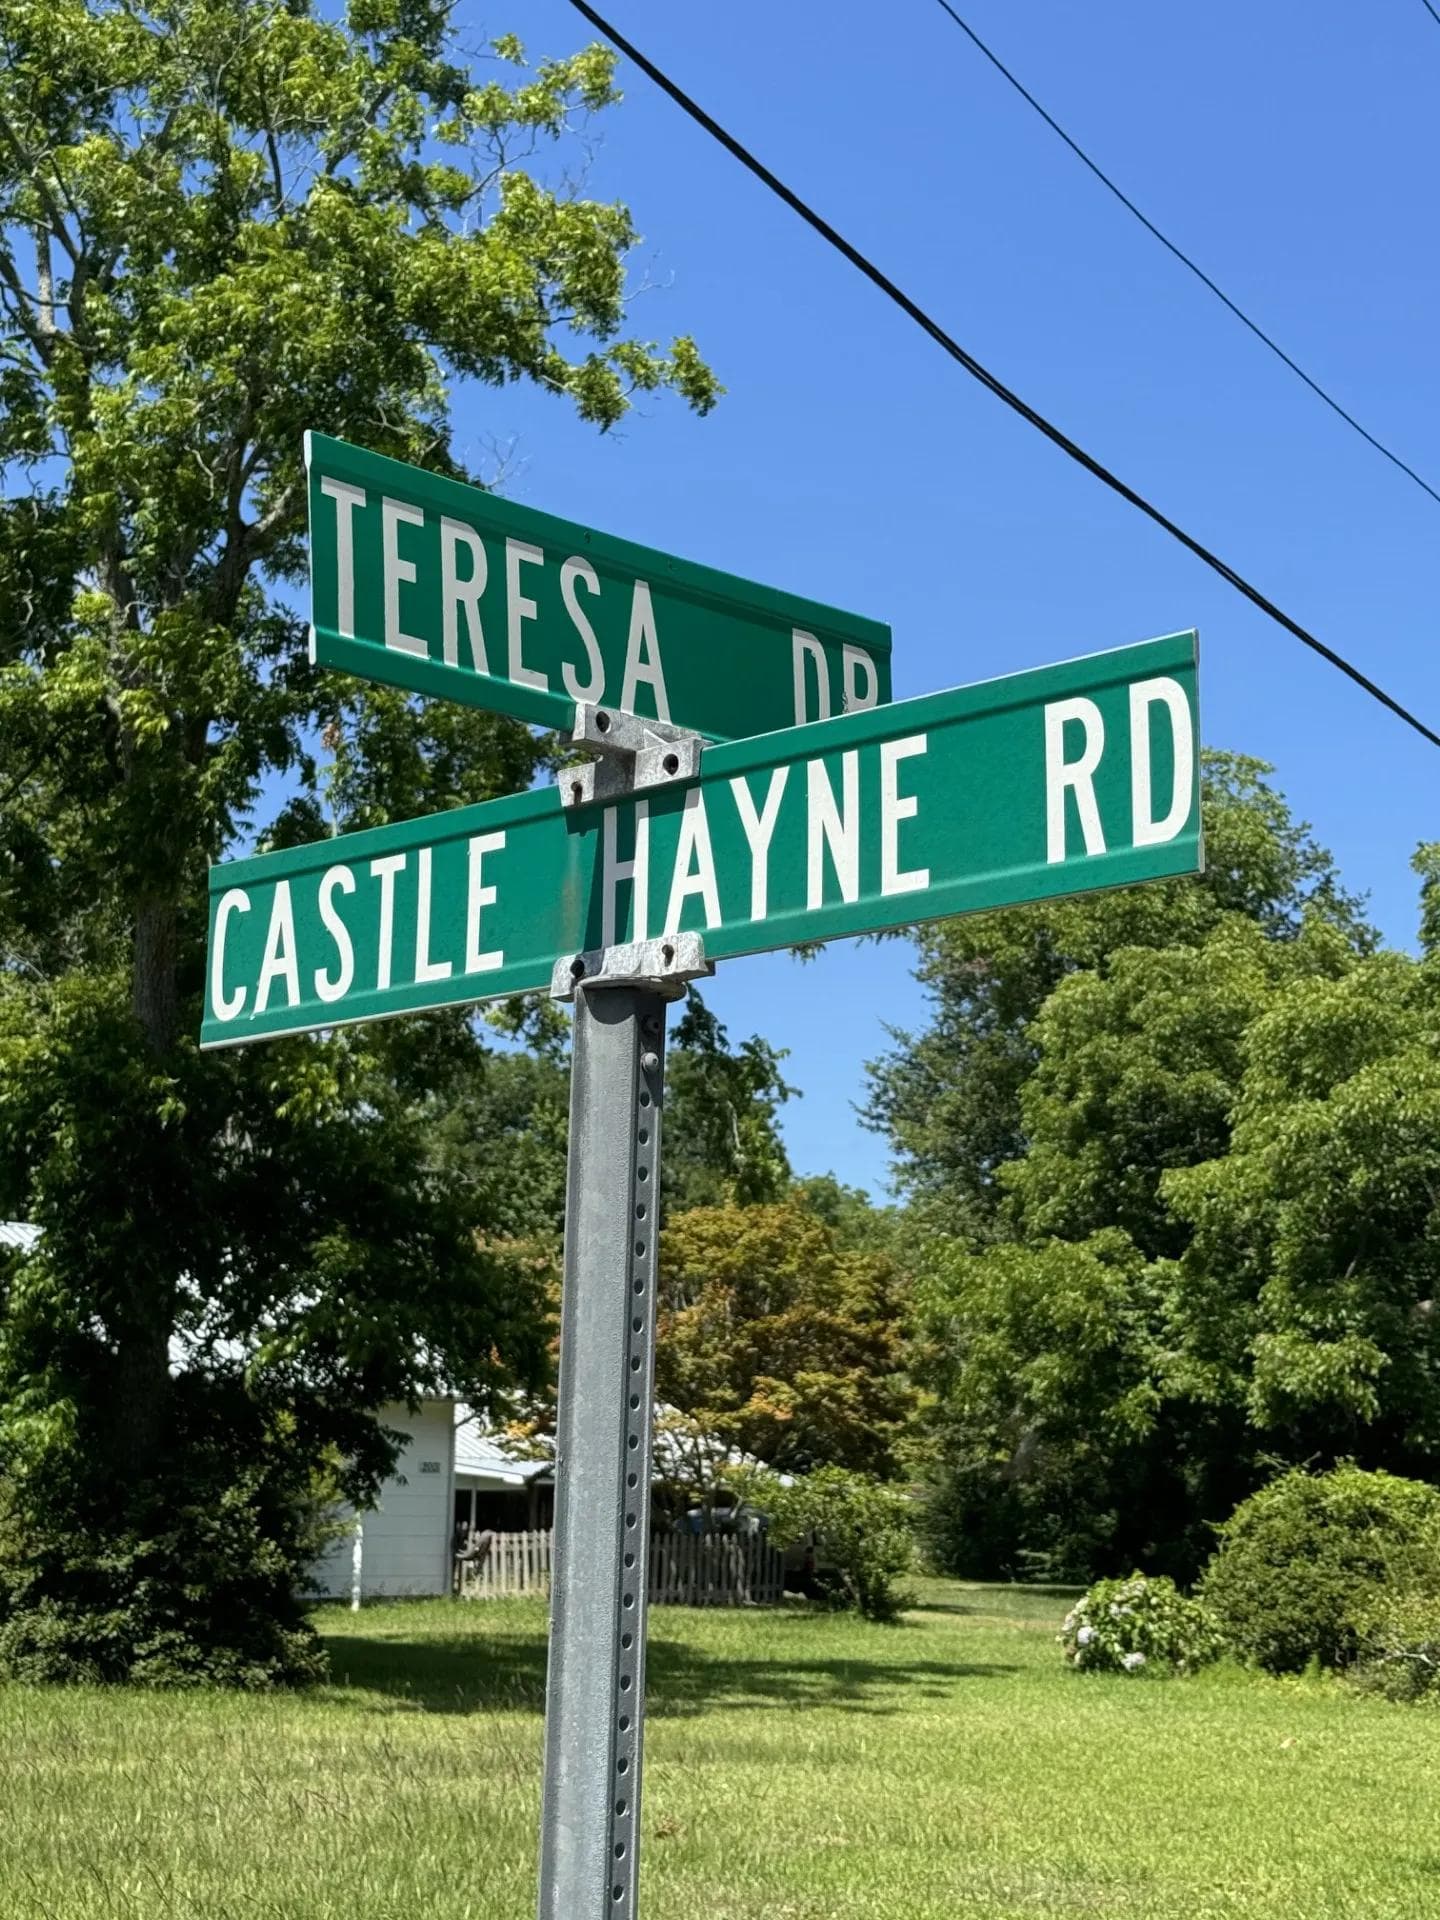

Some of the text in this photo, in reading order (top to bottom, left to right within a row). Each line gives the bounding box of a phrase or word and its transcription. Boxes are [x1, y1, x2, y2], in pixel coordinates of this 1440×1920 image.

[320, 475, 671, 724] TERESA
[211, 677, 1194, 1022] CASTLE HAYNE RD
